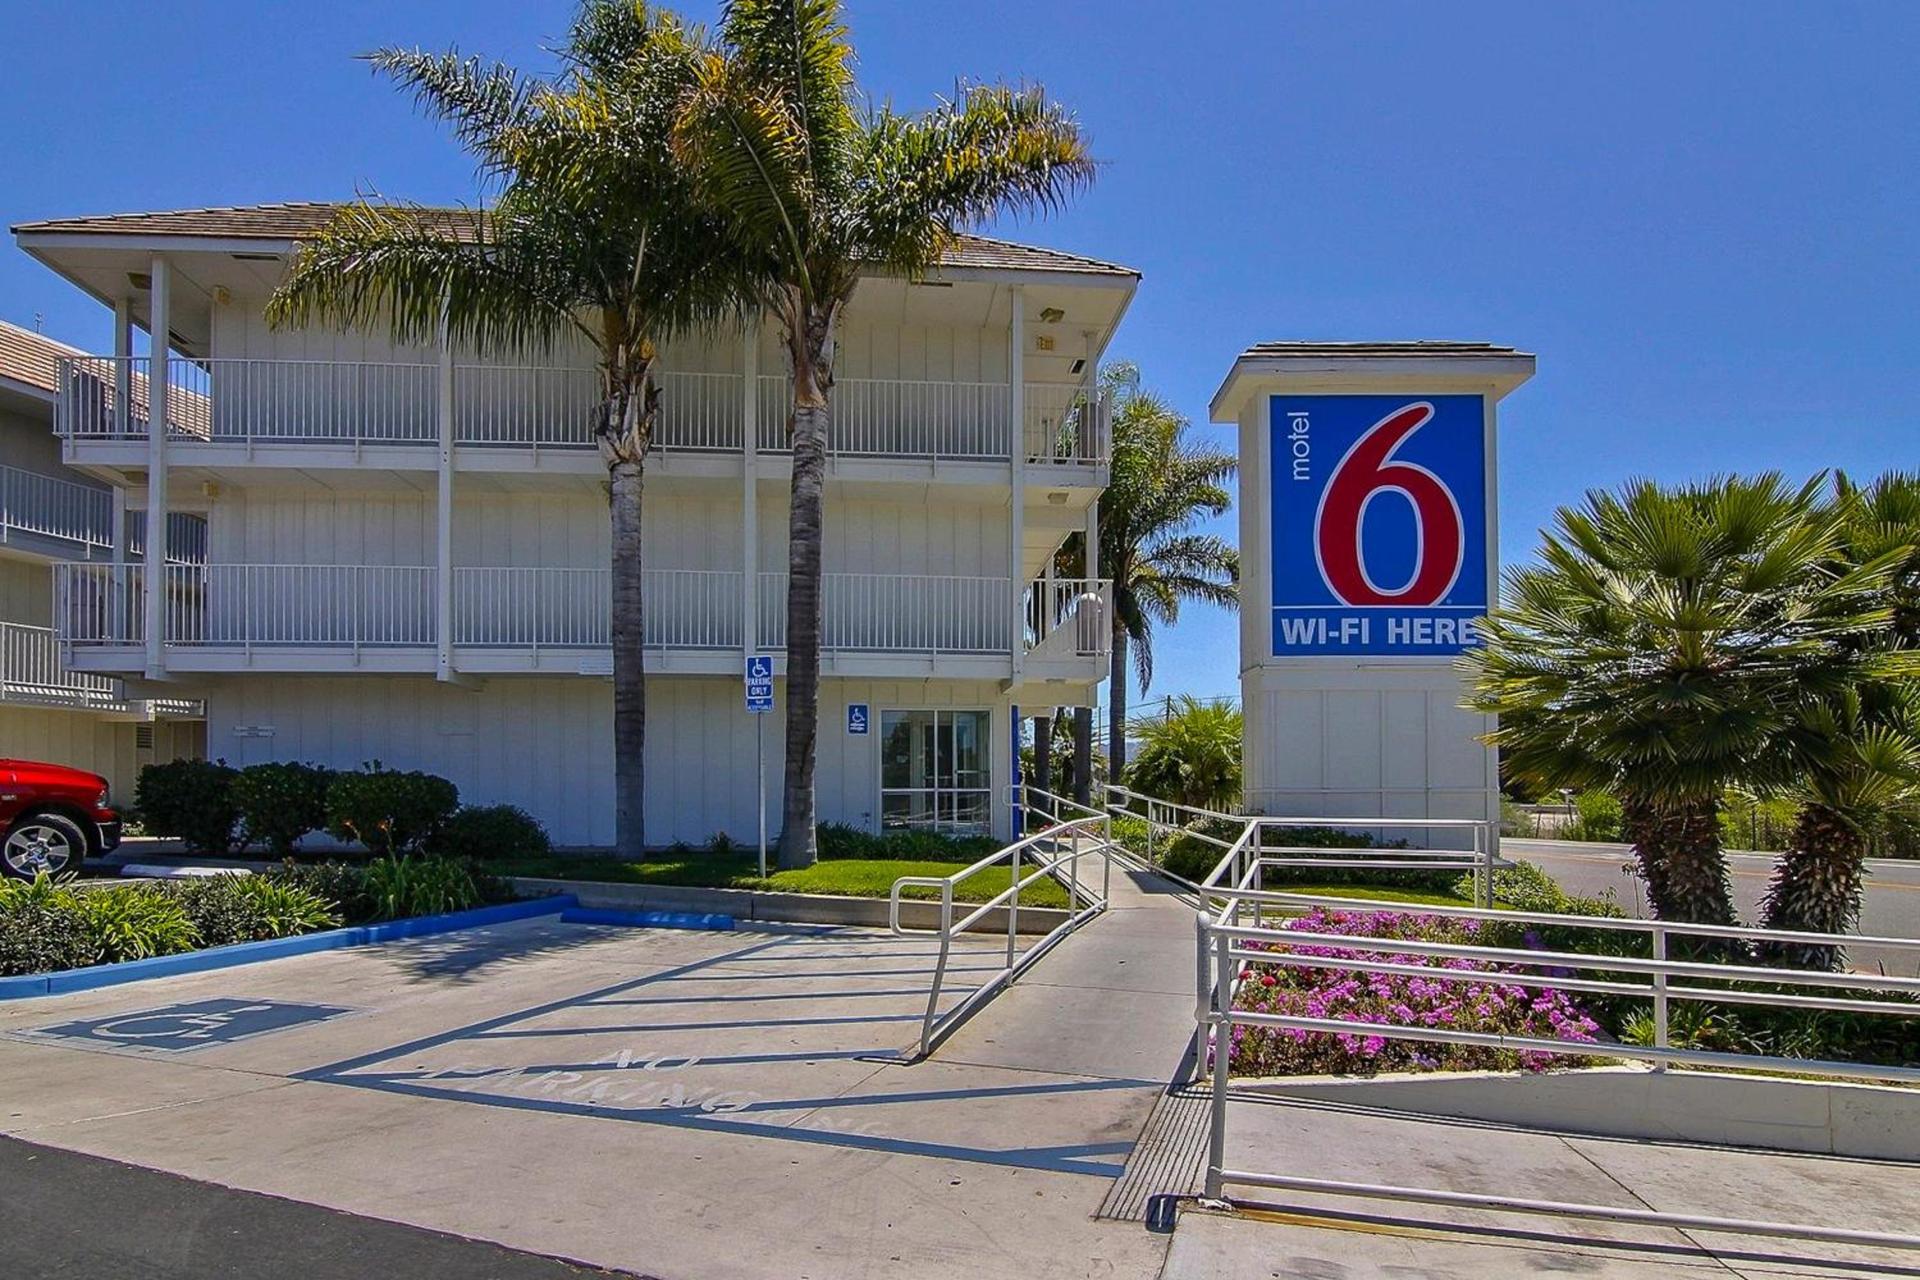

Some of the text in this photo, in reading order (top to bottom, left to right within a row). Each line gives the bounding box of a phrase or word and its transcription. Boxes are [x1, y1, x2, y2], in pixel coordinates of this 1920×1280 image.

[1287, 411, 1310, 481] motel
[1313, 400, 1465, 608] 6
[1281, 617, 1479, 645] WI-FI HERE
[751, 687, 767, 696] ONLY
